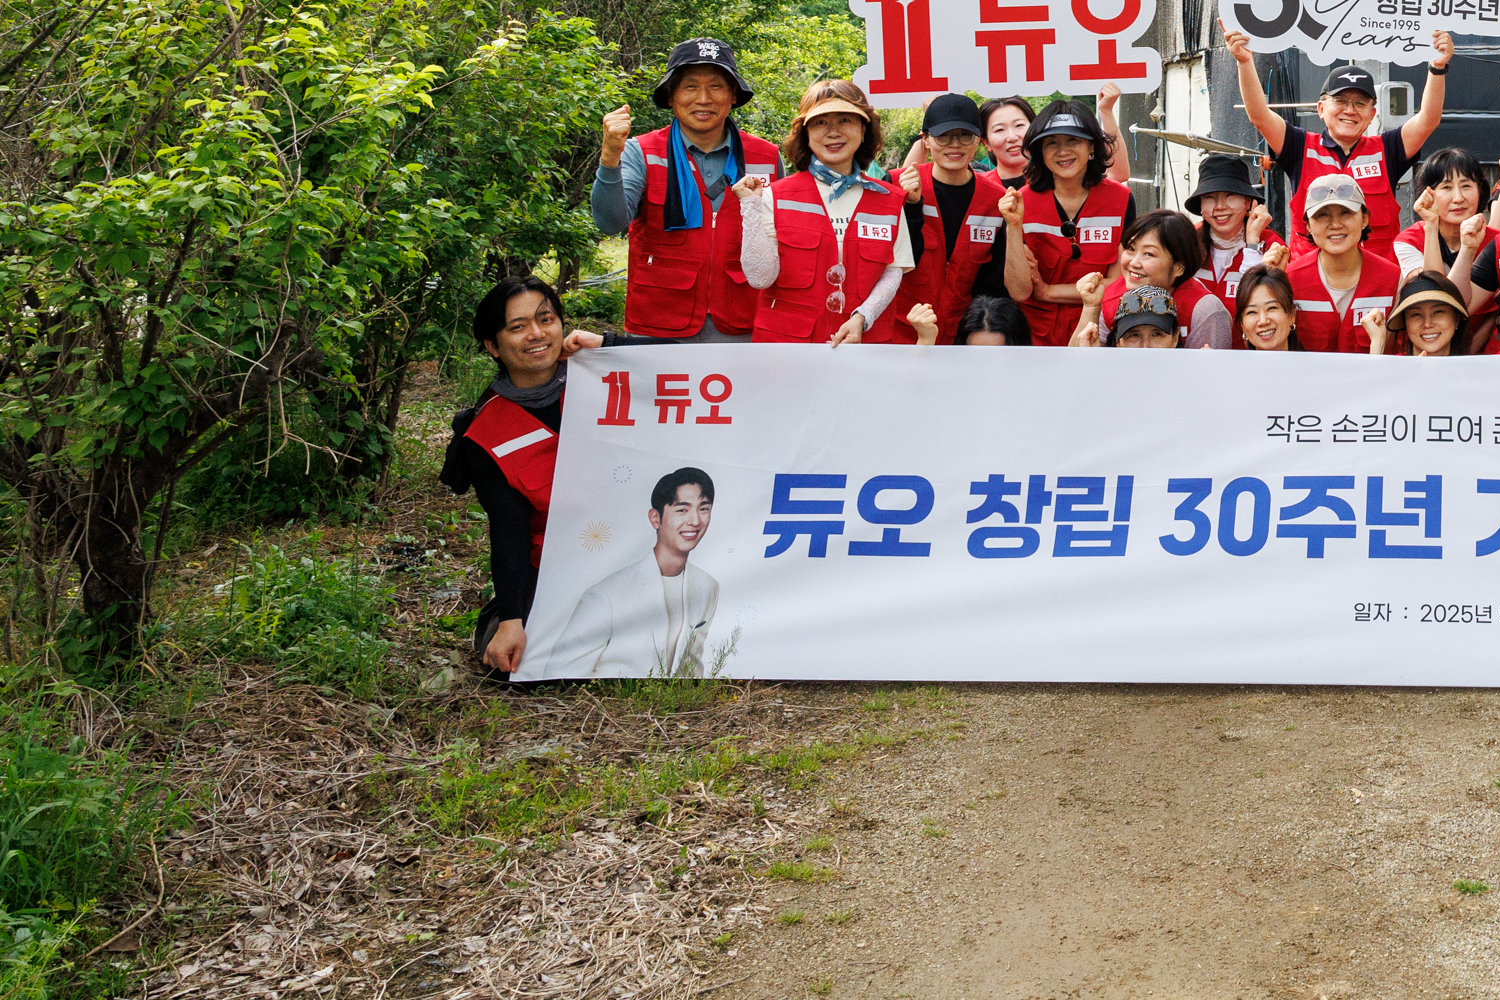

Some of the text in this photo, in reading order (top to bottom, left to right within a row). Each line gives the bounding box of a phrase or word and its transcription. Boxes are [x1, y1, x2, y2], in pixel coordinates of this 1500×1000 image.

[1360, 17, 1421, 31] Since1995
[1364, 165, 1378, 175] 듀오
[872, 227, 889, 238] 듀오
[980, 229, 993, 241] 듀오
[1093, 230, 1109, 241] 듀오
[654, 373, 733, 425] 듀오
[1265, 414, 1323, 443] 작은
[1331, 414, 1417, 443] 손길이
[1426, 415, 1482, 445] 모여
[763, 474, 935, 558] 듀오
[967, 474, 1134, 559] 창립
[1158, 474, 1443, 559] 30주년
[1354, 602, 1392, 622] 일자
[1420, 604, 1492, 624] 2025년
